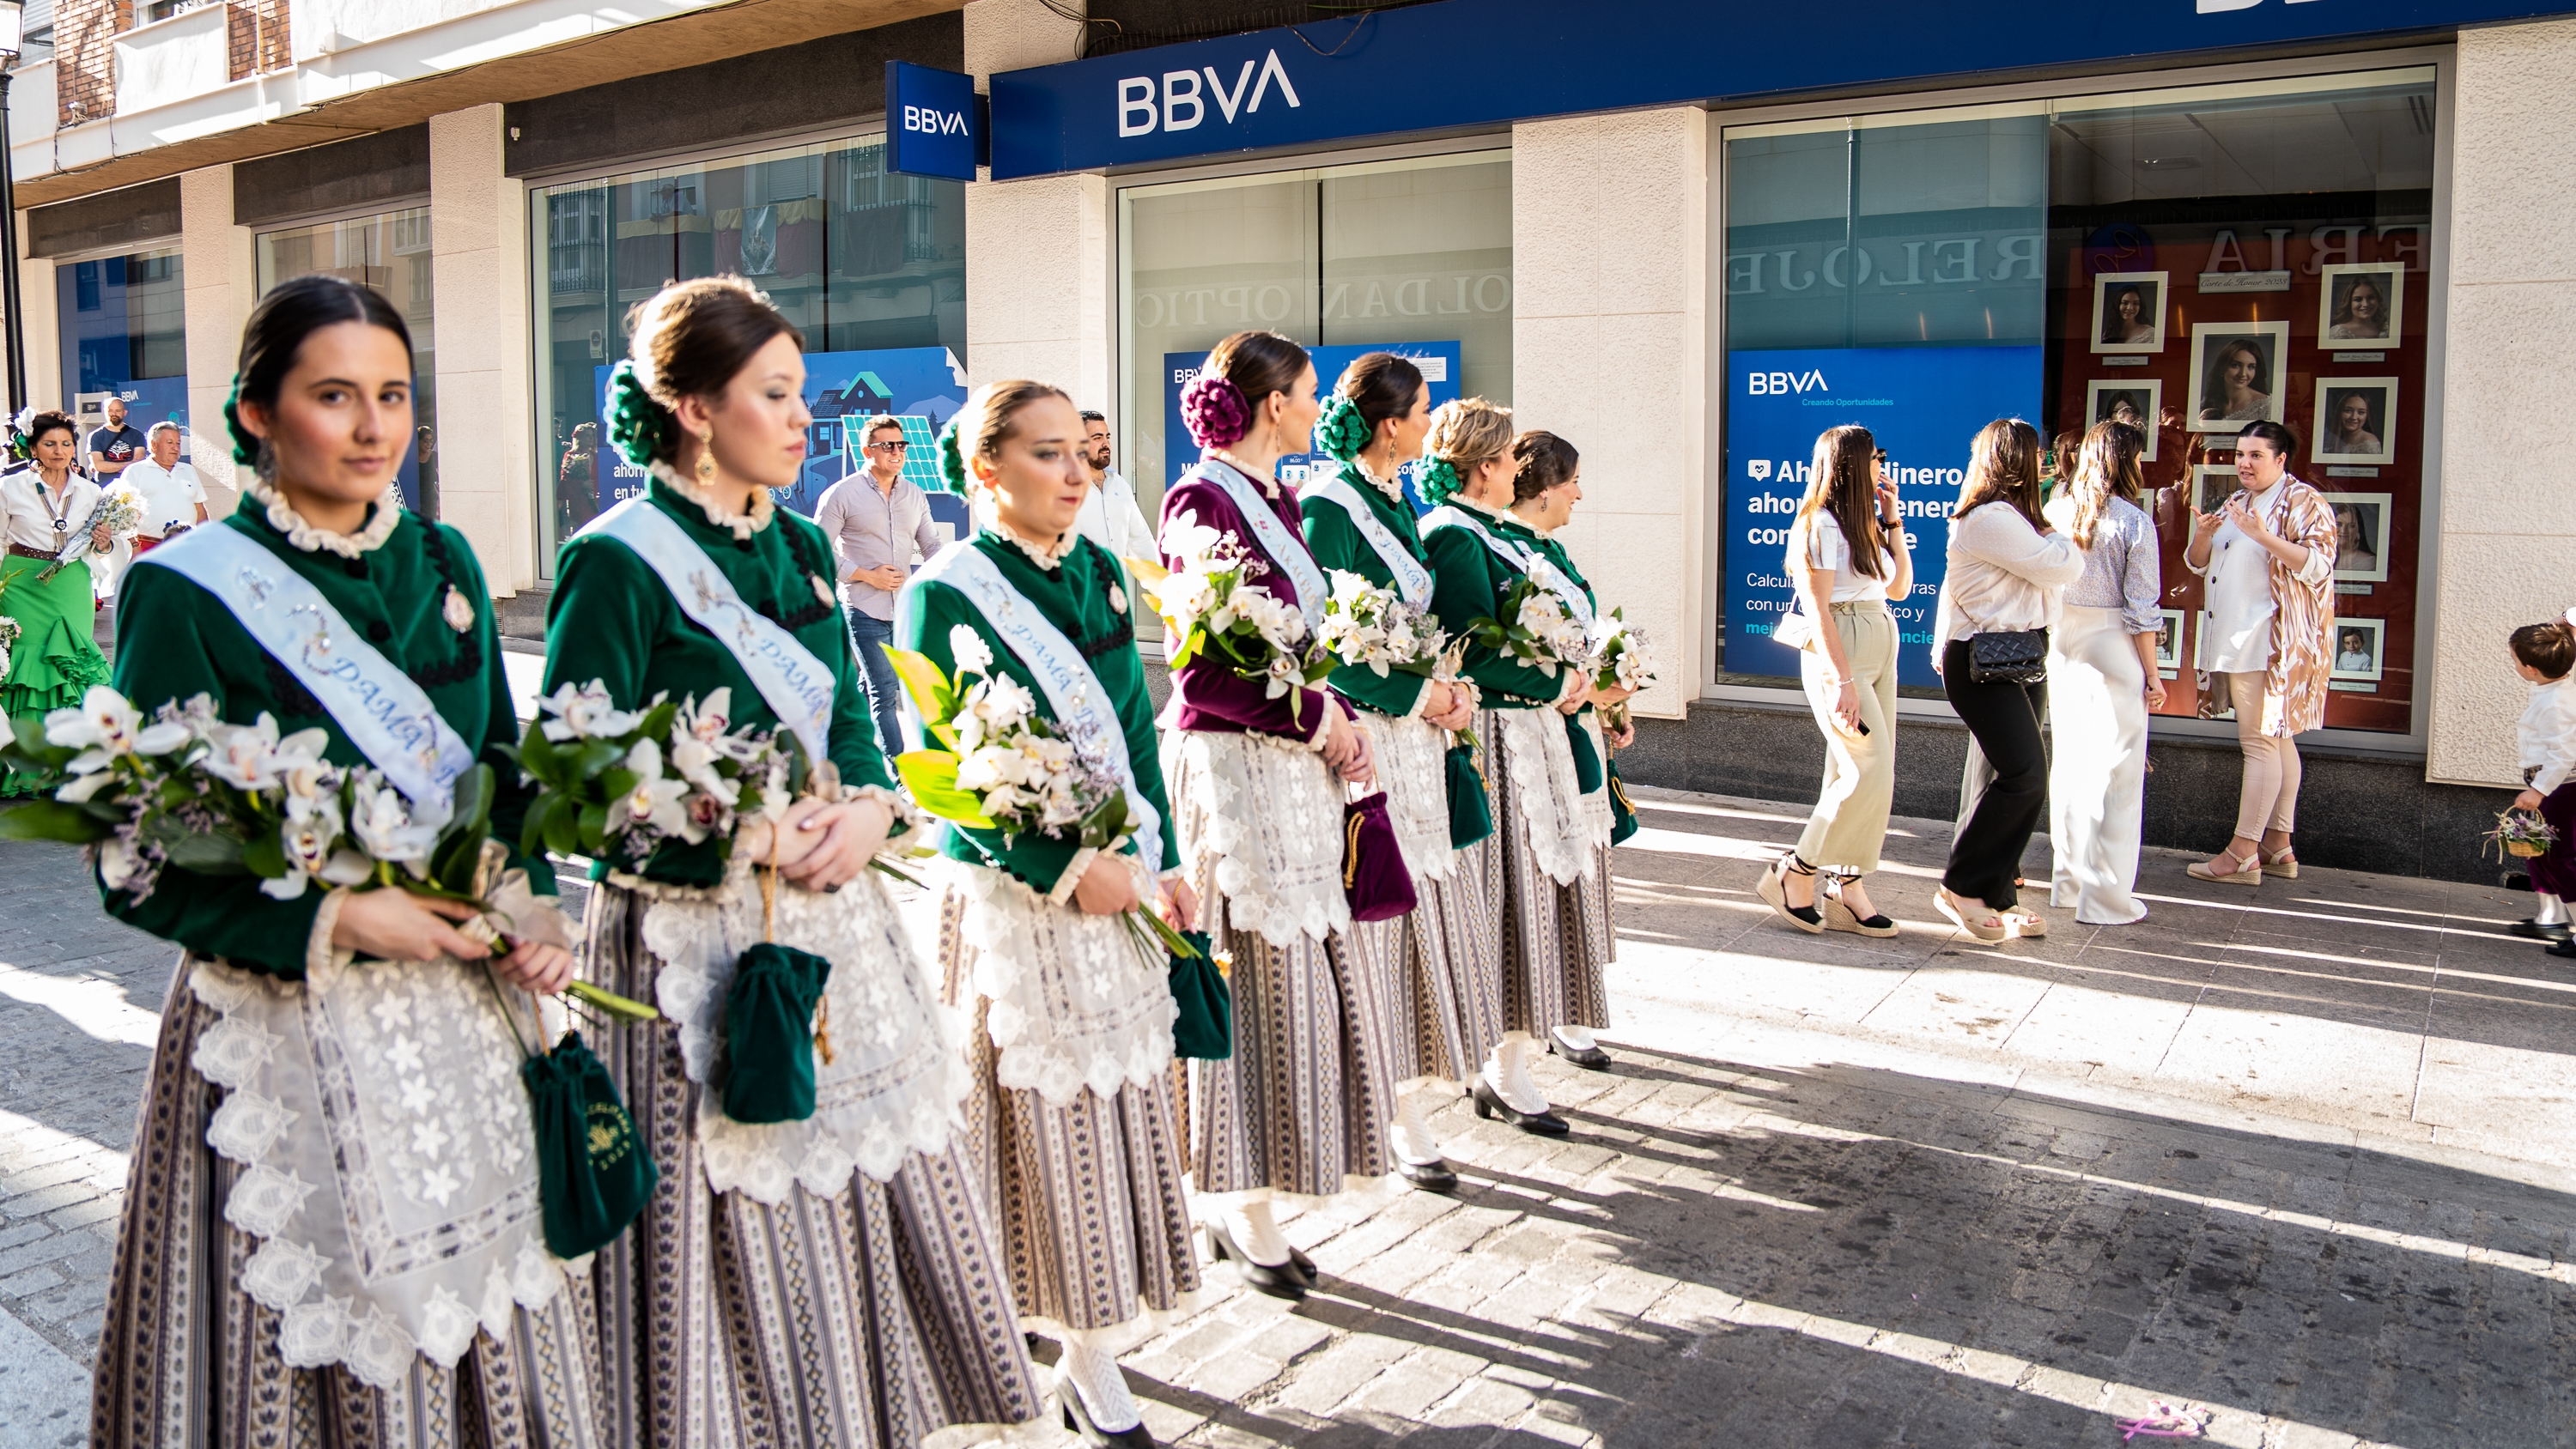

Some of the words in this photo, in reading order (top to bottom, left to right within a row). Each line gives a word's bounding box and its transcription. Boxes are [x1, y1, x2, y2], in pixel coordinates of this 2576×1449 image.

[1118, 48, 1301, 137] BBVA
[904, 106, 969, 136] BBVA
[2201, 279, 2222, 288] Corte
[2235, 277, 2262, 287] Honor
[1749, 368, 1828, 395] BBVA
[121, 390, 138, 403] BBVA
[1836, 397, 1893, 408] Oportunidades
[1880, 461, 1964, 486] dinero
[614, 487, 629, 500] en
[1746, 599, 1772, 611] con
[1915, 608, 1925, 622] y
[1017, 622, 1072, 692] DAMA
[759, 637, 825, 717] DAMA
[329, 656, 423, 754] DAMA
